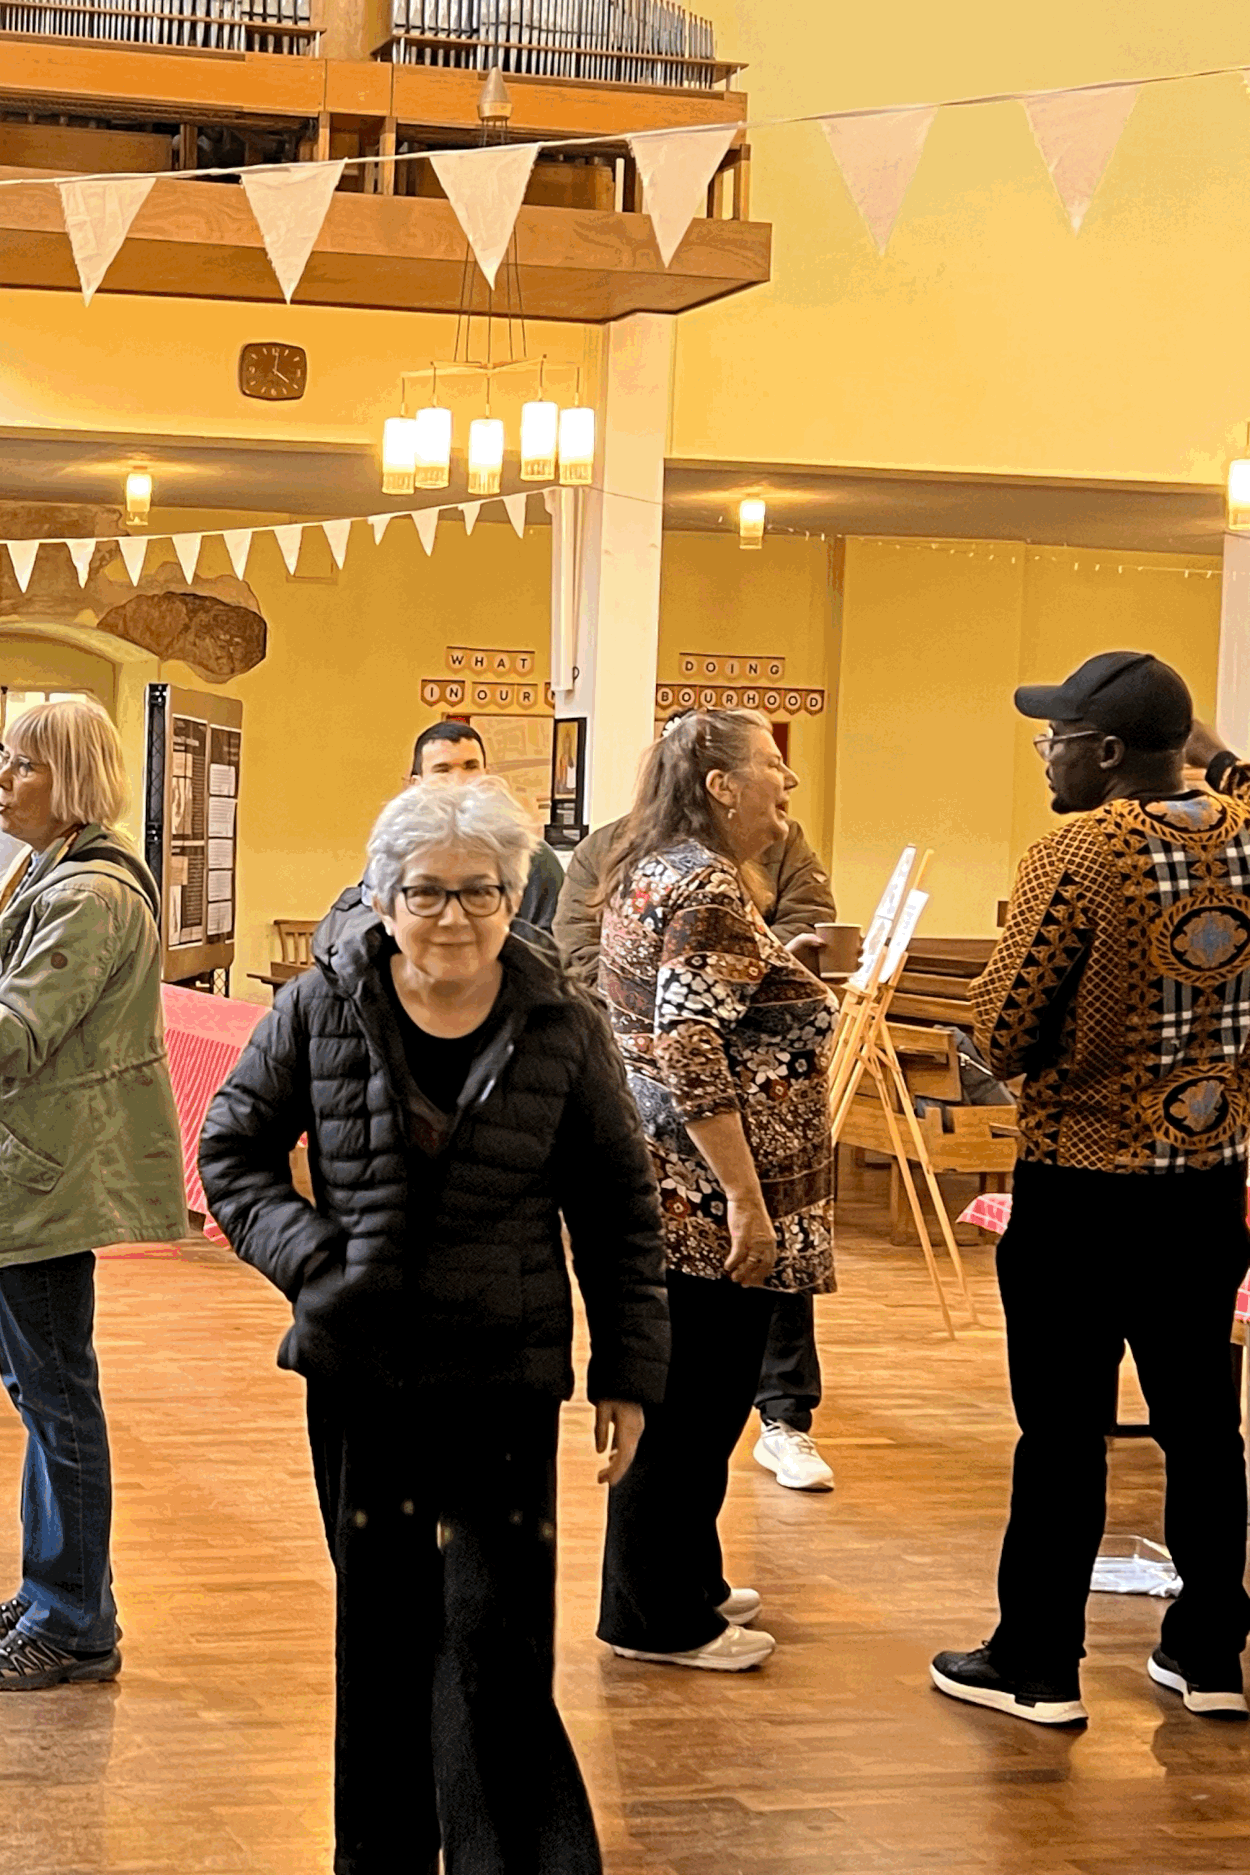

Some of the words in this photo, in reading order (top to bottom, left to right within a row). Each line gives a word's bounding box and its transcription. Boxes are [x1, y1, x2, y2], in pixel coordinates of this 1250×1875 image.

[451, 654, 528, 669] WHAT
[685, 660, 780, 675] DOING
[430, 686, 459, 699] IN
[477, 689, 531, 702] OUR
[661, 691, 818, 707] BOURHOOD
